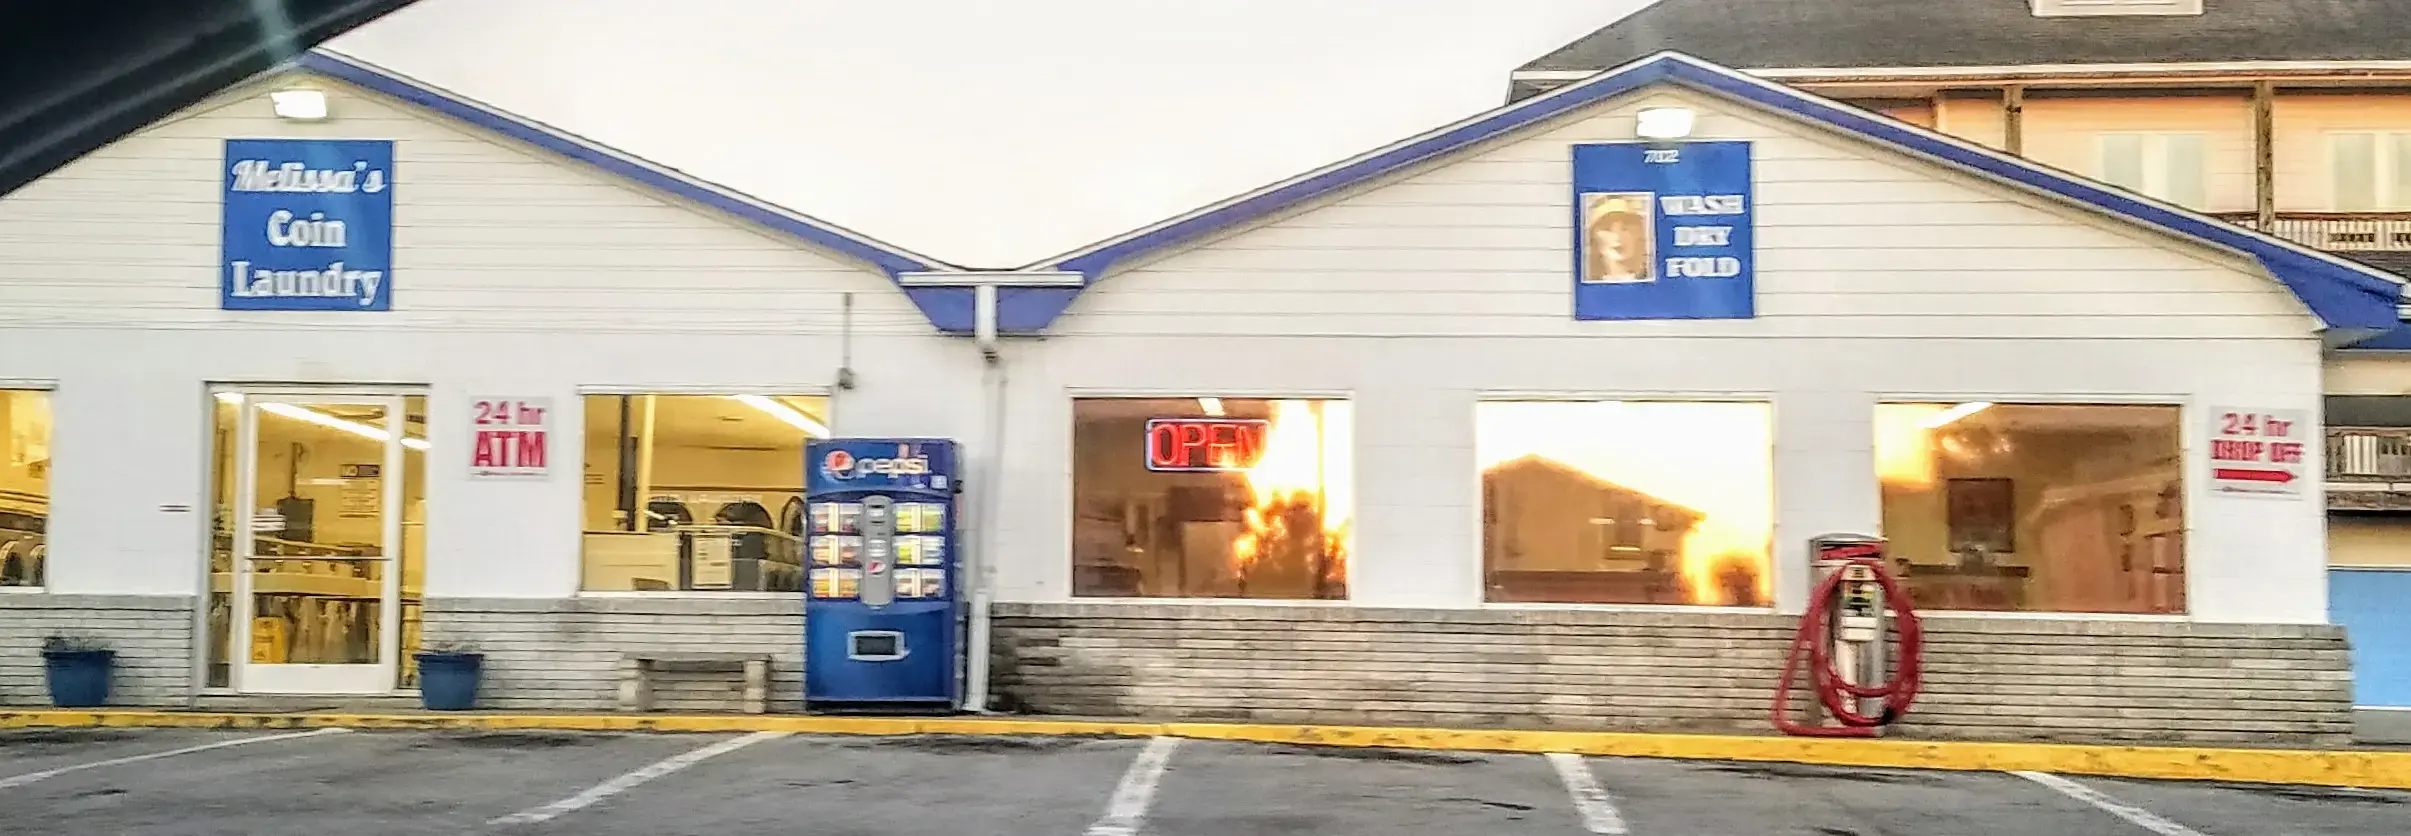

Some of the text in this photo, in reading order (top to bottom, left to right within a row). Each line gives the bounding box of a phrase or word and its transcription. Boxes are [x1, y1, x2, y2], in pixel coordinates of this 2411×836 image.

[231, 159, 387, 193] Melissa's
[1659, 194, 1745, 216] WASH
[267, 209, 347, 248] Coin
[1673, 225, 1734, 247] DRY
[1664, 256, 1741, 278] FOLD
[231, 259, 383, 306] Laundry
[473, 400, 547, 425] 24 hr
[2222, 412, 2294, 437] 24 hr
[471, 430, 547, 468] ATM
[1151, 423, 1268, 467] OPEN
